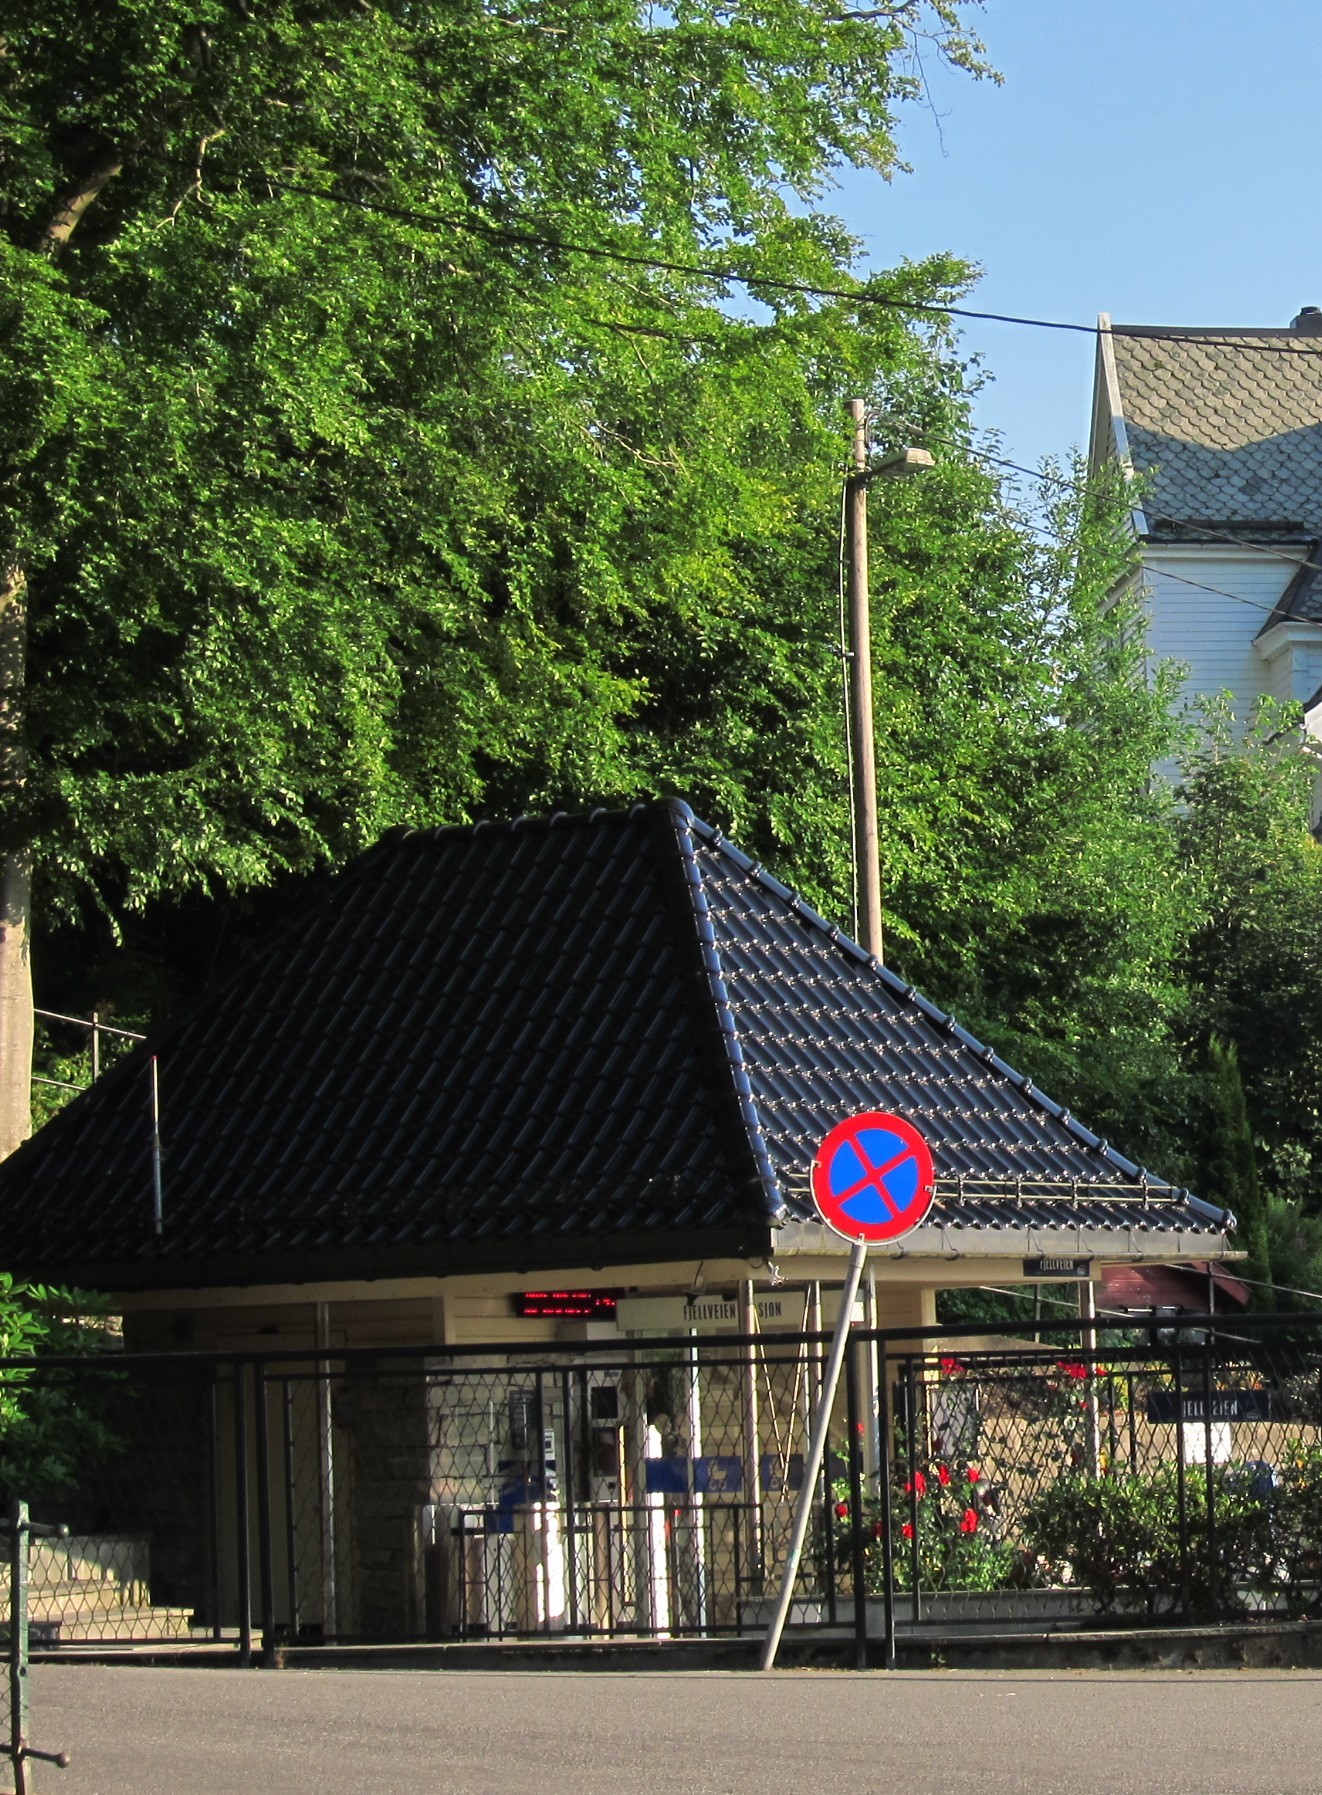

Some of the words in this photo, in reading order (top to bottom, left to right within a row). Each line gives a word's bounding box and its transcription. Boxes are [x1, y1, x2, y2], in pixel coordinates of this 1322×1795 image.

[683, 1303, 736, 1321] FJELLVEIEN
[743, 1301, 782, 1319] SJON
[1178, 1399, 1238, 1418] JELLEIEN
